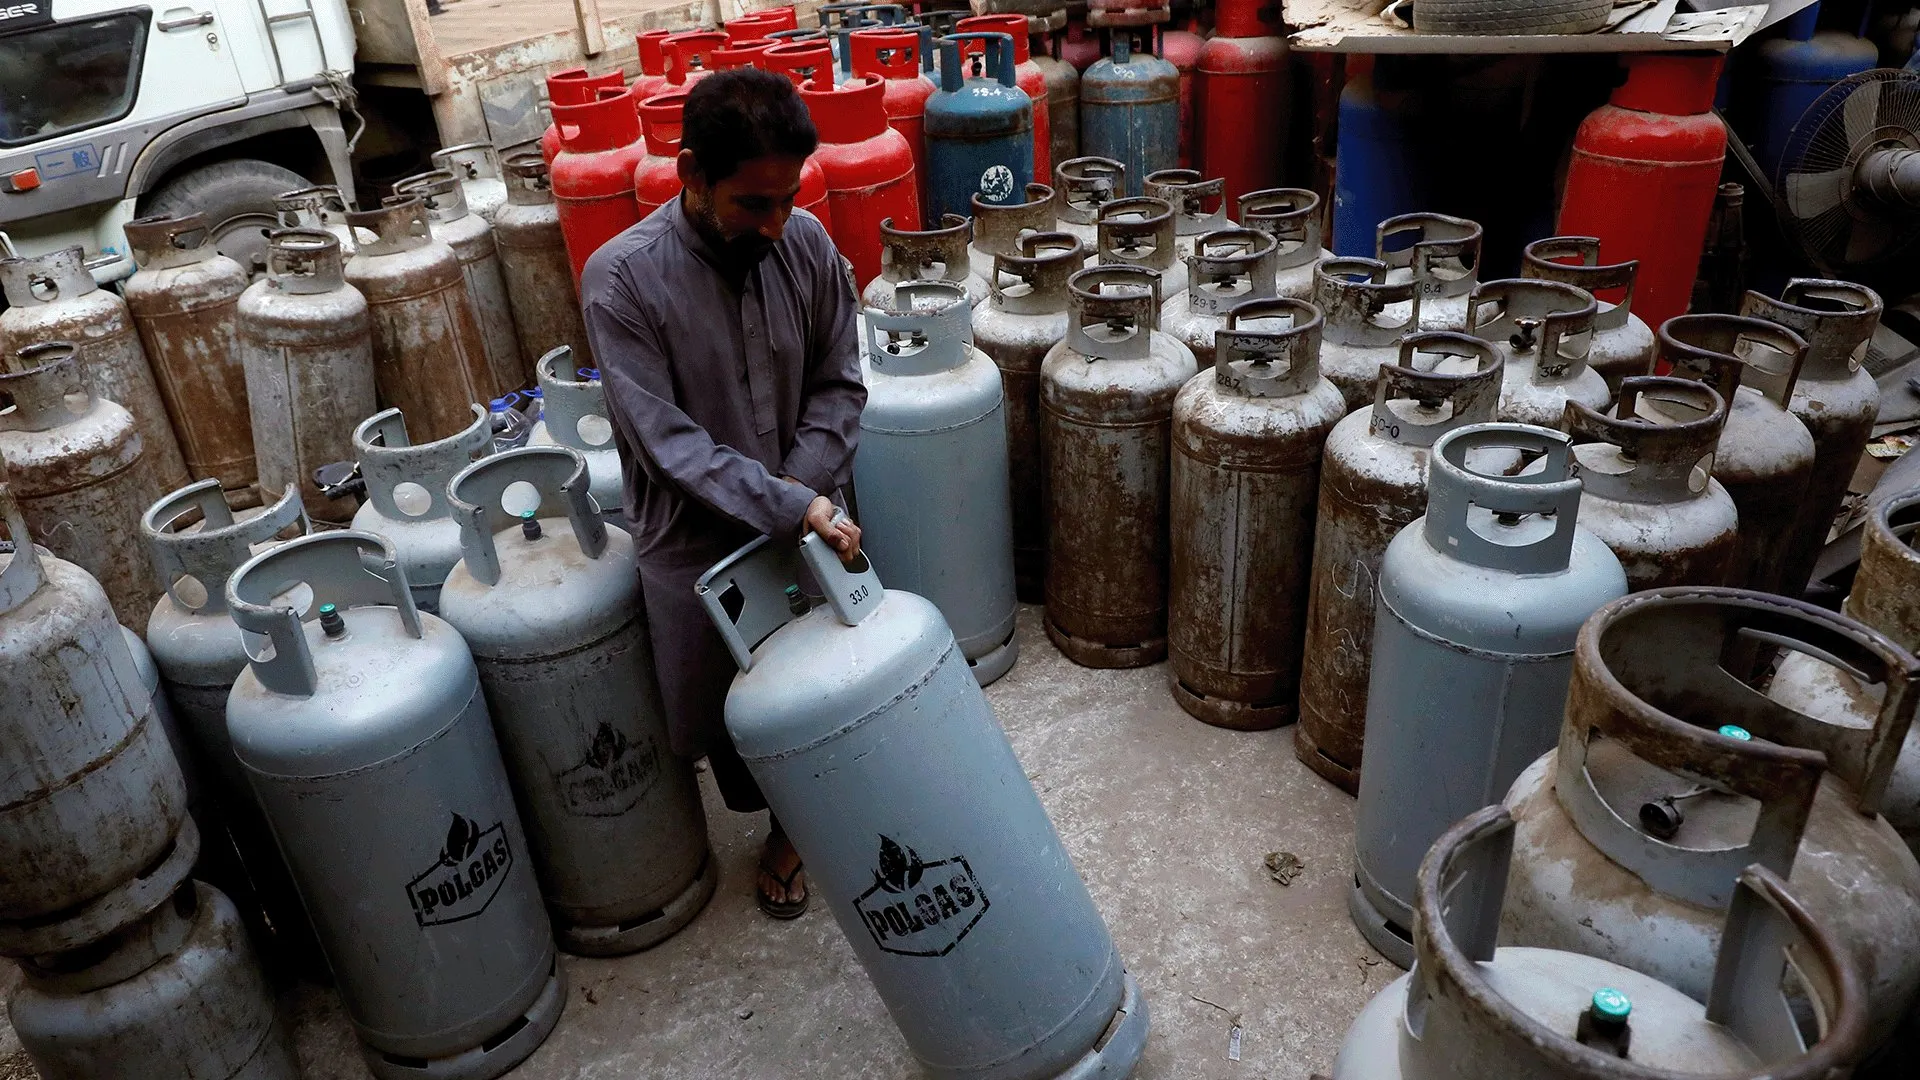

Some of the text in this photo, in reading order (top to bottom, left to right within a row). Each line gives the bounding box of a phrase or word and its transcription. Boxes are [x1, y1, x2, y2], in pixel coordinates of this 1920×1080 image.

[850, 585, 868, 605] 33.0
[418, 838, 507, 915] POLGAS
[865, 874, 976, 940] POLGAS
